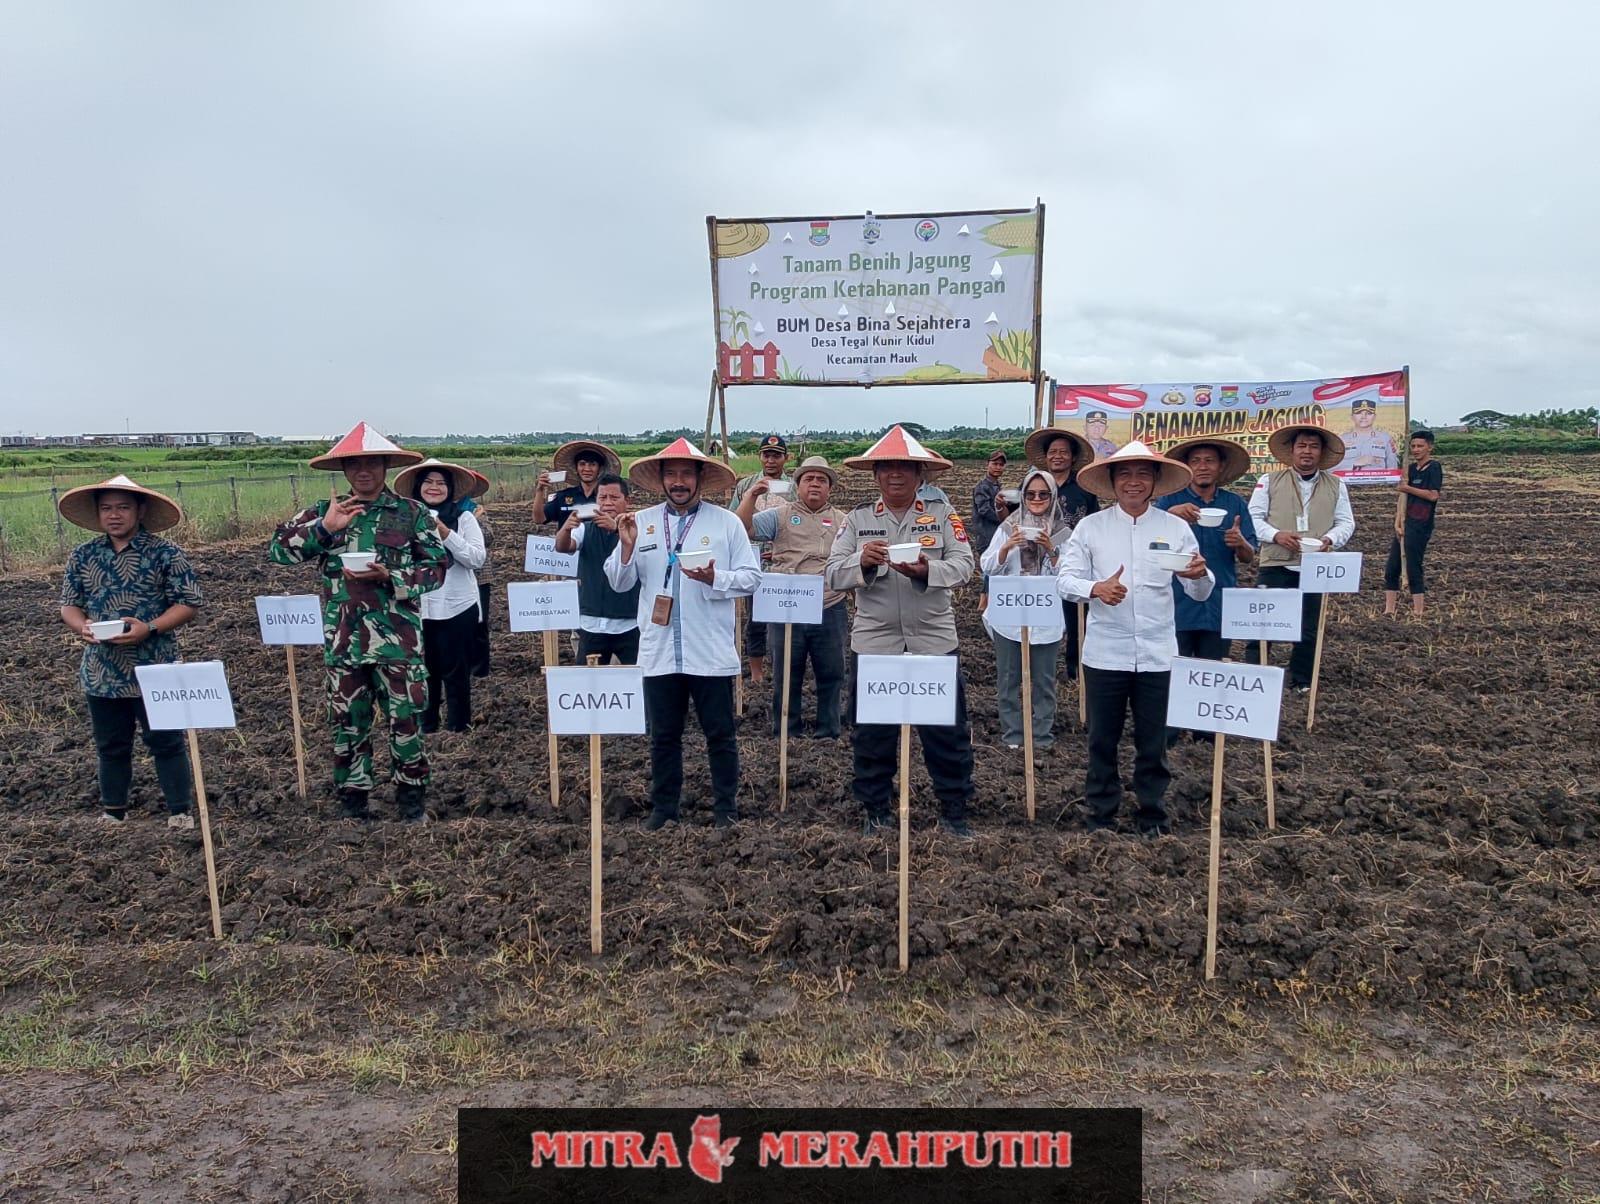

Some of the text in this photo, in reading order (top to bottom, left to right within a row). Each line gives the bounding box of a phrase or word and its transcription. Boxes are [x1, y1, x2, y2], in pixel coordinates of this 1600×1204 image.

[782, 250, 972, 274] Tanam Benih Jagung
[750, 275, 1006, 305] Program Ketahanan Pangan
[777, 314, 971, 333] BUM Desa Bina Sejahtera
[811, 334, 935, 350] Desa Tegal Kunir Kidul
[827, 352, 918, 365] Kecamatan Mauk
[1132, 404, 1326, 443] PENANAMAN JAGUNG
[911, 524, 941, 533] POLRI
[534, 556, 570, 568] TARUNA
[1316, 565, 1346, 579] PLD
[762, 587, 815, 597] PENDAMPING
[535, 596, 553, 604] KASI
[778, 600, 798, 608] DESA
[996, 593, 1053, 607] SEKDES
[518, 609, 571, 617] PEMBERDAYAAN
[1249, 602, 1276, 614] BPP
[265, 613, 316, 626] BINWAS
[867, 681, 947, 697] KAPOLSEK
[1188, 670, 1265, 694] KEPALA
[151, 689, 223, 703] DANRAMIL
[558, 693, 635, 711] CAMAT
[1197, 701, 1249, 724] DESA
